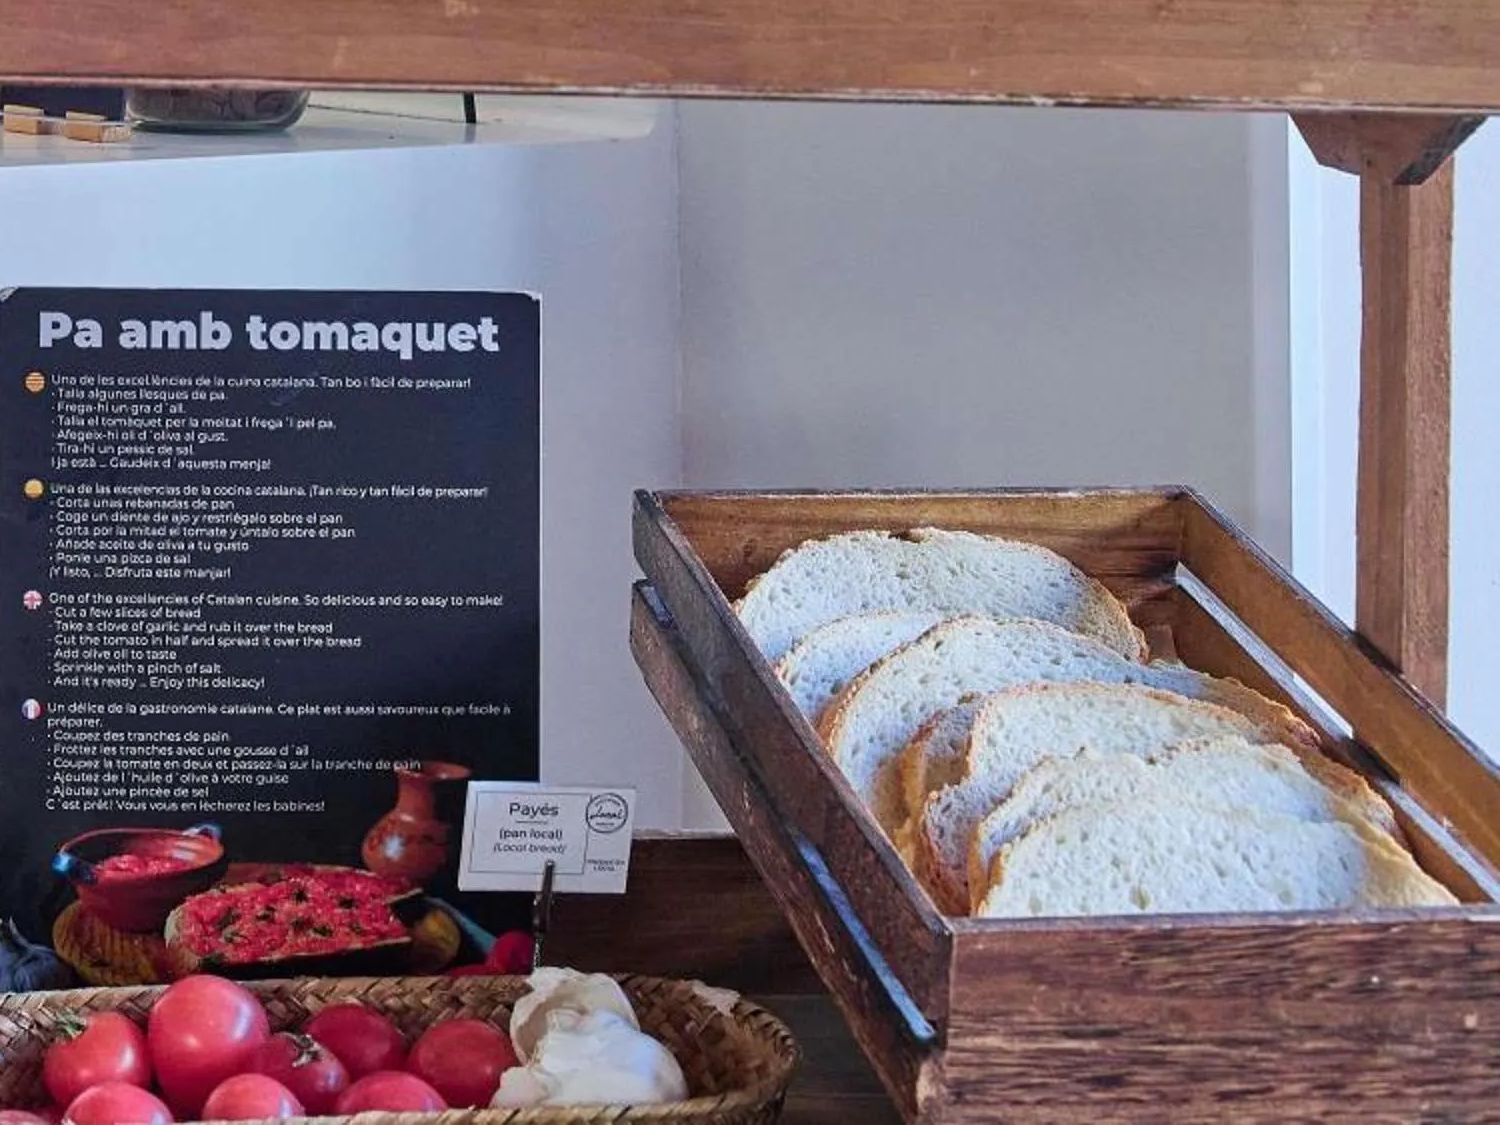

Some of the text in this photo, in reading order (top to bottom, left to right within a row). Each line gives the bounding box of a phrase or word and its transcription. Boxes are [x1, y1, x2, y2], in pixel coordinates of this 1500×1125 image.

[39, 311, 500, 359] Pa amb tomaquet
[52, 375, 413, 388] Una de de cuina Tan bo de
[58, 389, 206, 402] Talla algunes llesques de
[132, 404, 150, 415] gra
[58, 416, 242, 429] Talla per meitat
[158, 444, 172, 455] de
[51, 484, 432, 496] Una de de cocina de
[57, 497, 234, 511] Corta unas rebanadas de pan
[56, 511, 342, 525] Coge un diente de sobre pan
[56, 525, 355, 539] Corta por mitad tomate sobre pan
[99, 539, 249, 552] aceite de oliva gusto
[96, 553, 190, 566] una pizca de sal
[156, 567, 181, 577] este
[50, 593, 447, 609] One the Catalan delicious and easy
[55, 607, 201, 617] Cut few slices bread
[55, 621, 333, 634] Take clove garlic and rub over the bread
[55, 634, 361, 648] Cut the tomato half and spread over the bread
[54, 648, 177, 659] Add olive oil taste
[54, 662, 221, 675] Sprinkle with pinch salt
[54, 676, 208, 689] And ready Enjoy this
[47, 703, 500, 716] Un délice de gastronomie Ce plat est aussi savoureux que facile
[54, 730, 228, 744] Coupez des tranches de pain
[54, 744, 277, 758] Frottez les tranches avec une gousse
[54, 758, 420, 772] Coupez tomate en deux sur tranche de pain
[53, 772, 252, 785] Ajoutez de votre
[53, 786, 208, 798] Ajoutez une de sel
[117, 799, 270, 810] Vous vous en les
[510, 802, 559, 818] Payés
[500, 827, 563, 840] (pan local)
